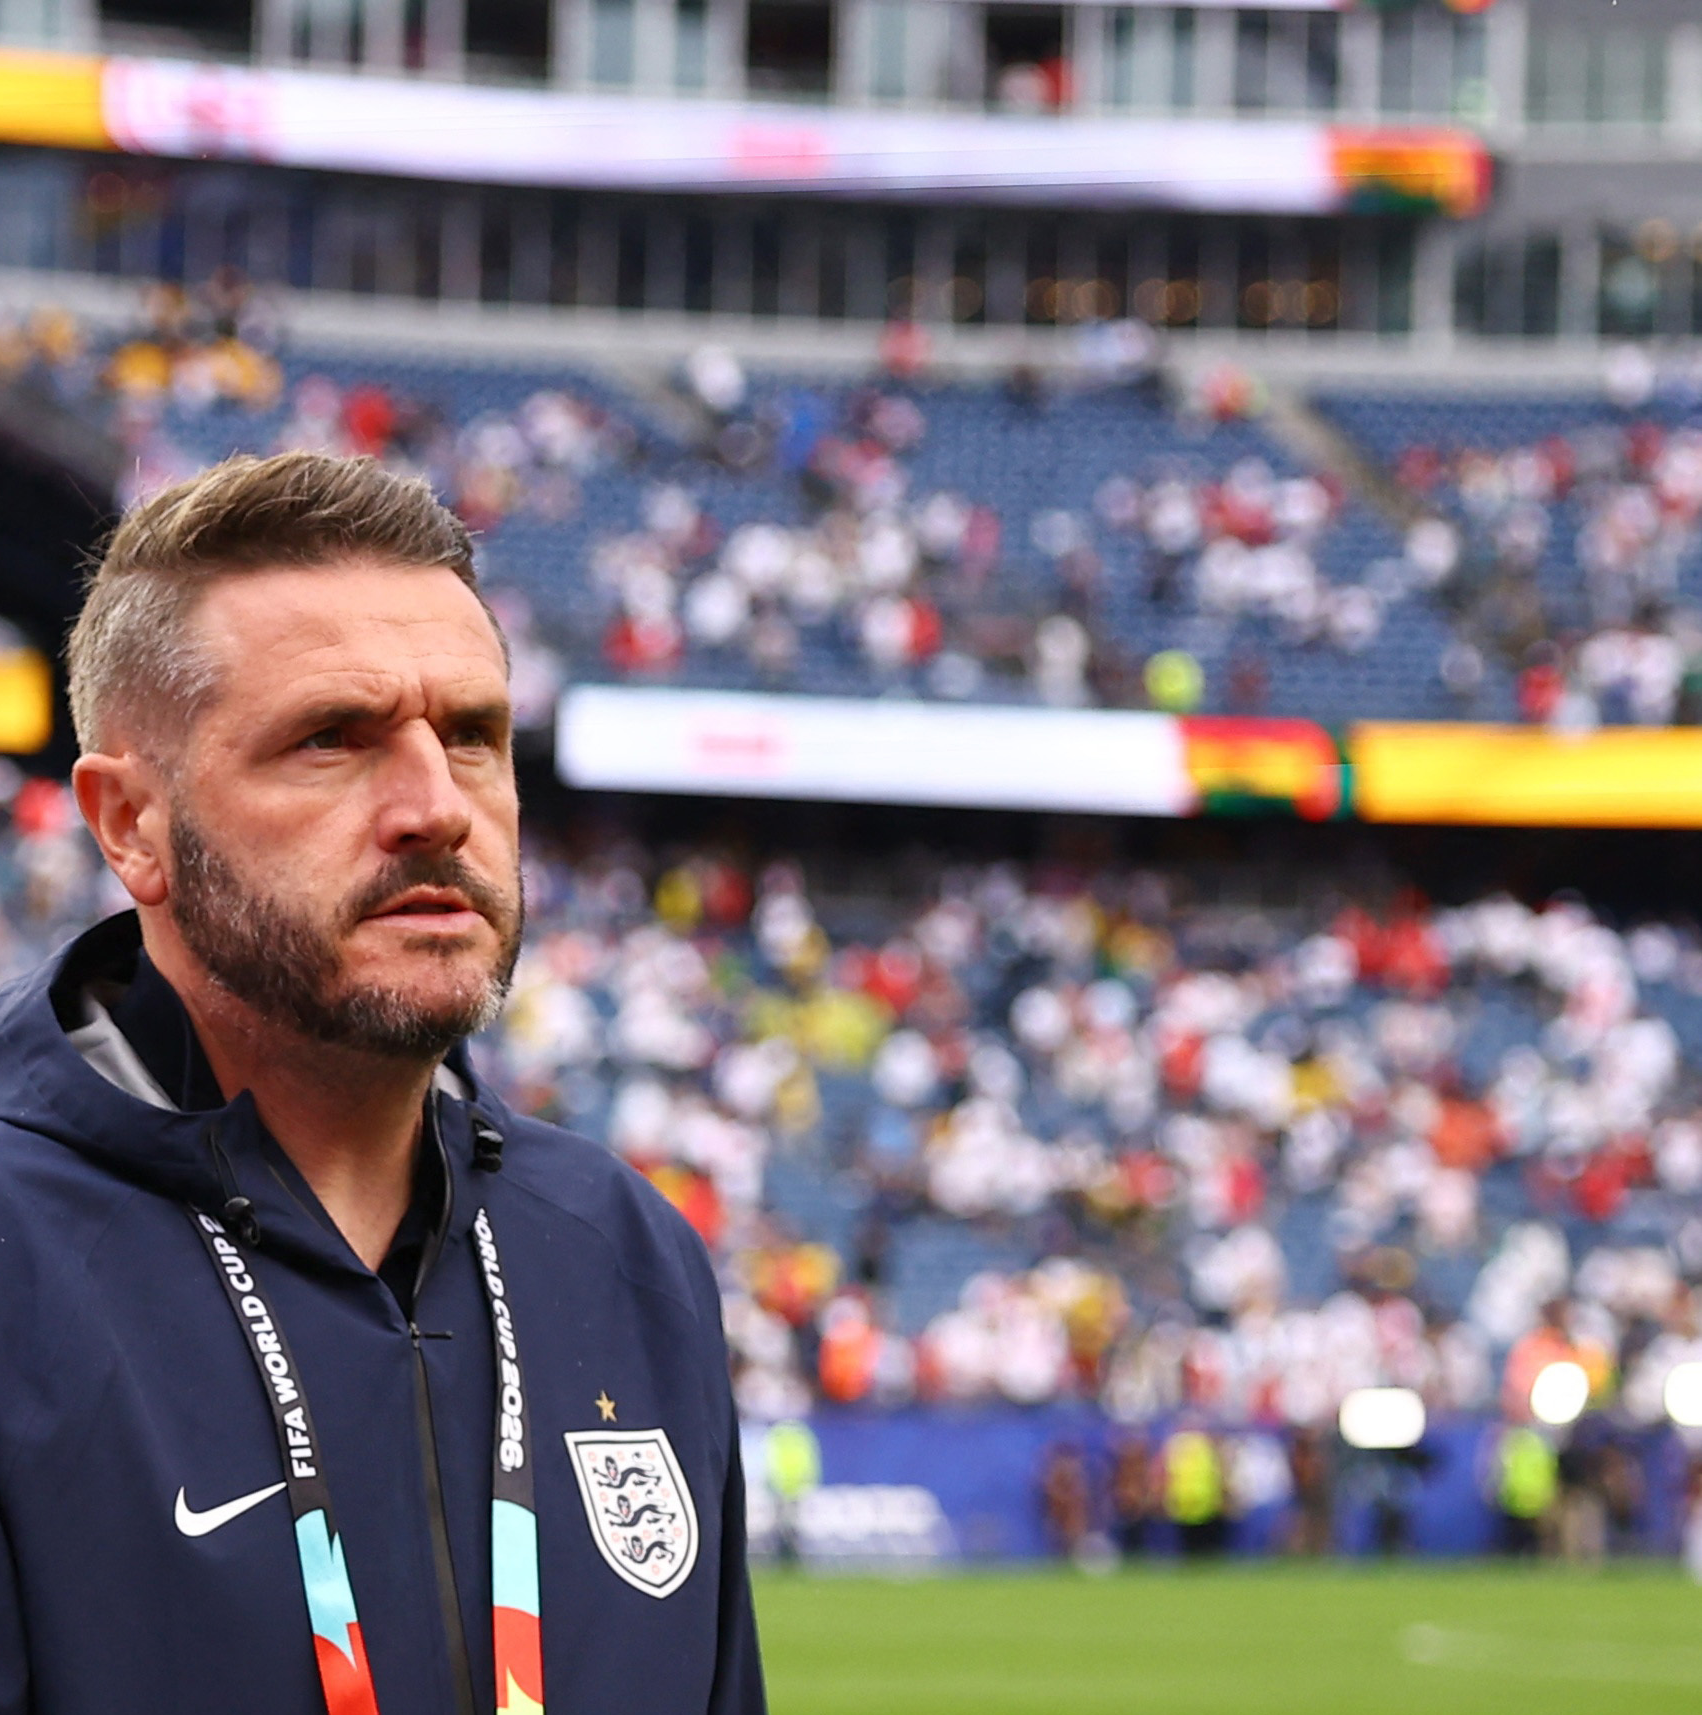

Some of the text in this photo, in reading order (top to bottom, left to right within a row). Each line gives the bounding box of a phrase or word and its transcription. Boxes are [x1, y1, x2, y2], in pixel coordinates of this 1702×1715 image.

[212, 1236, 255, 1293] CUP
[240, 1295, 299, 1404] WORLD
[492, 1298, 517, 1360] CUP
[283, 1406, 317, 1478] FIFA
[499, 1358, 525, 1472] 2026
